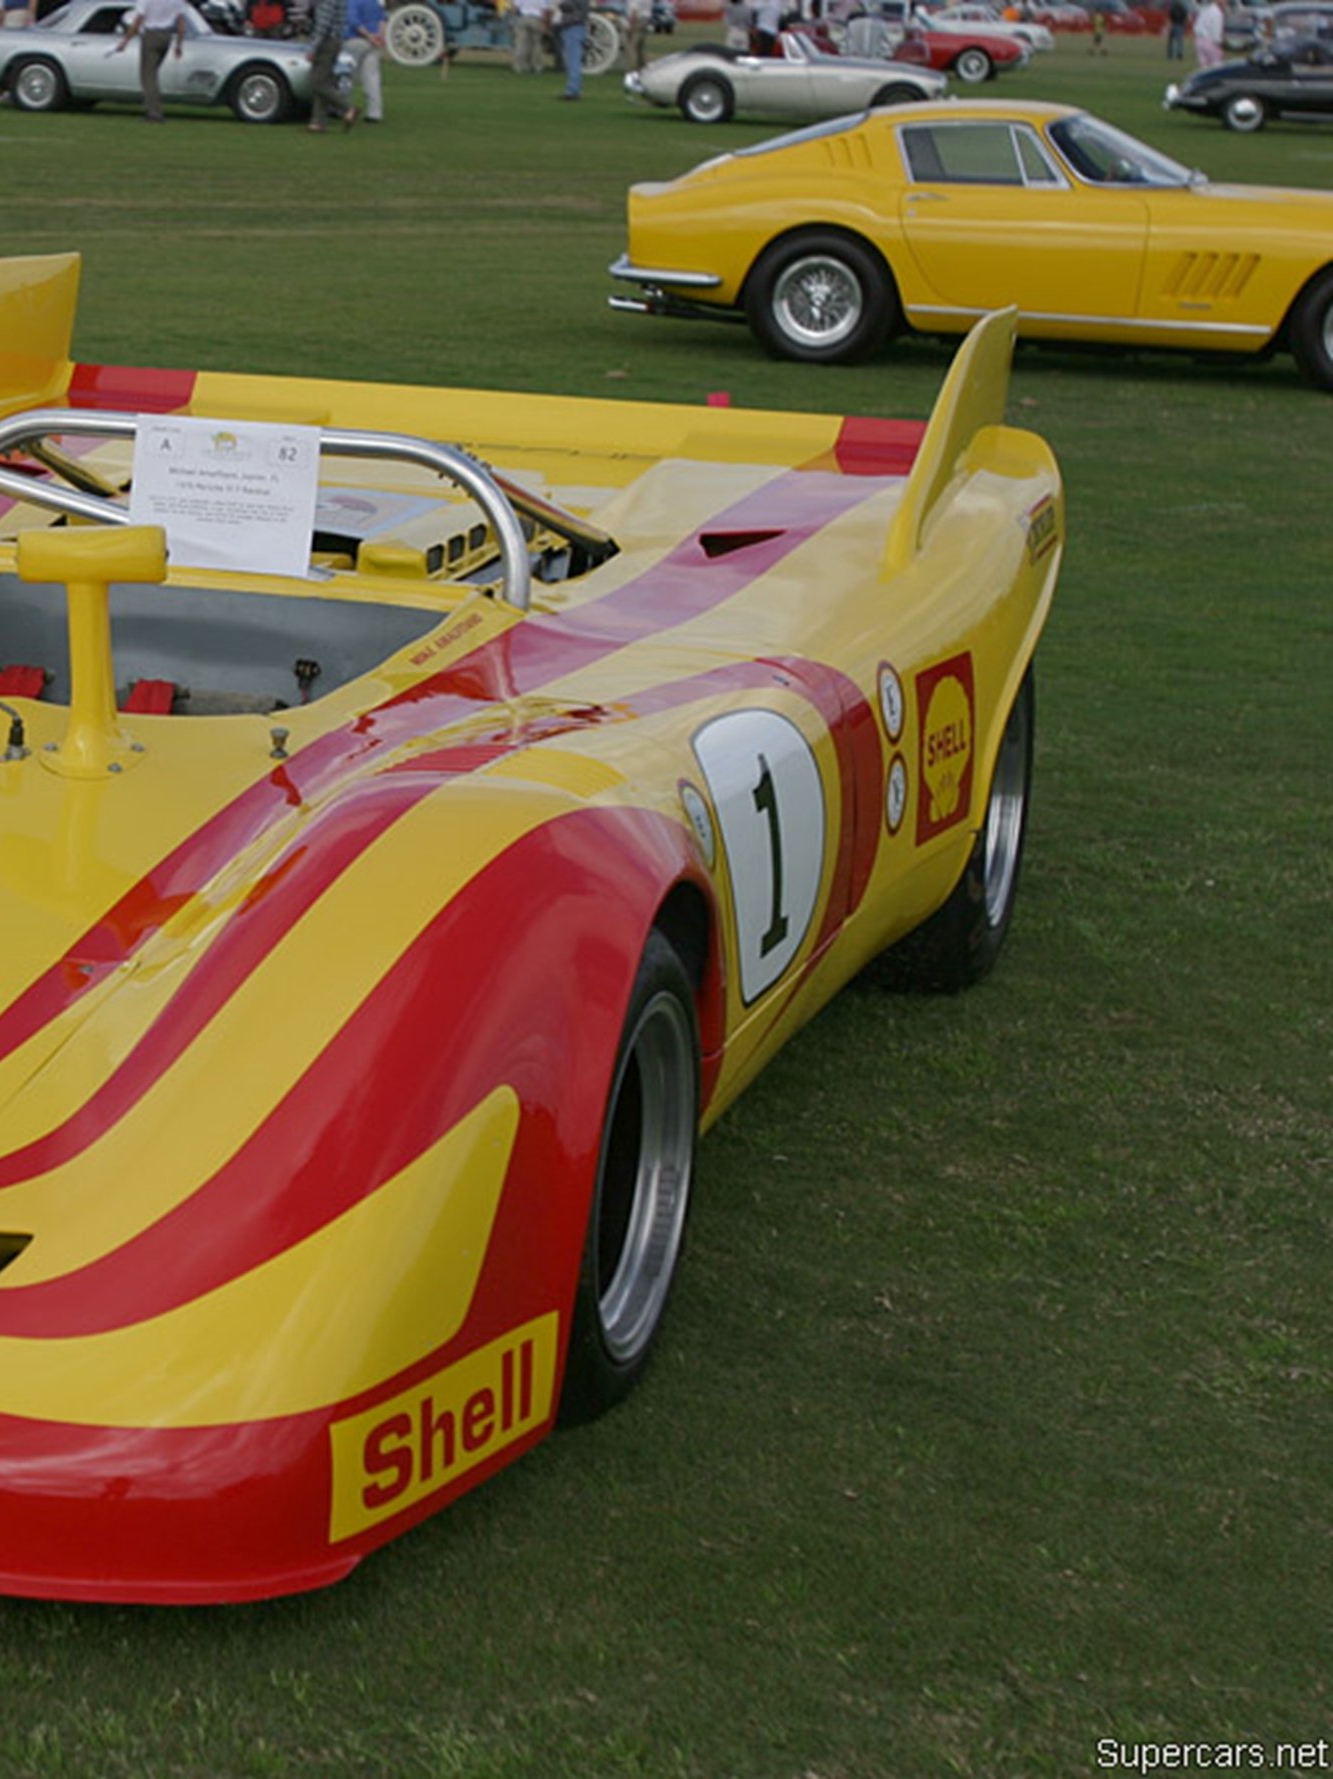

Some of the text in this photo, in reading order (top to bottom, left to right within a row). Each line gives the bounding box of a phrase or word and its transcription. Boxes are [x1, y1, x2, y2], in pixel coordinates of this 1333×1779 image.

[927, 718, 966, 767] SHELL
[752, 753, 789, 959] 1
[362, 1338, 534, 1510] Shell
